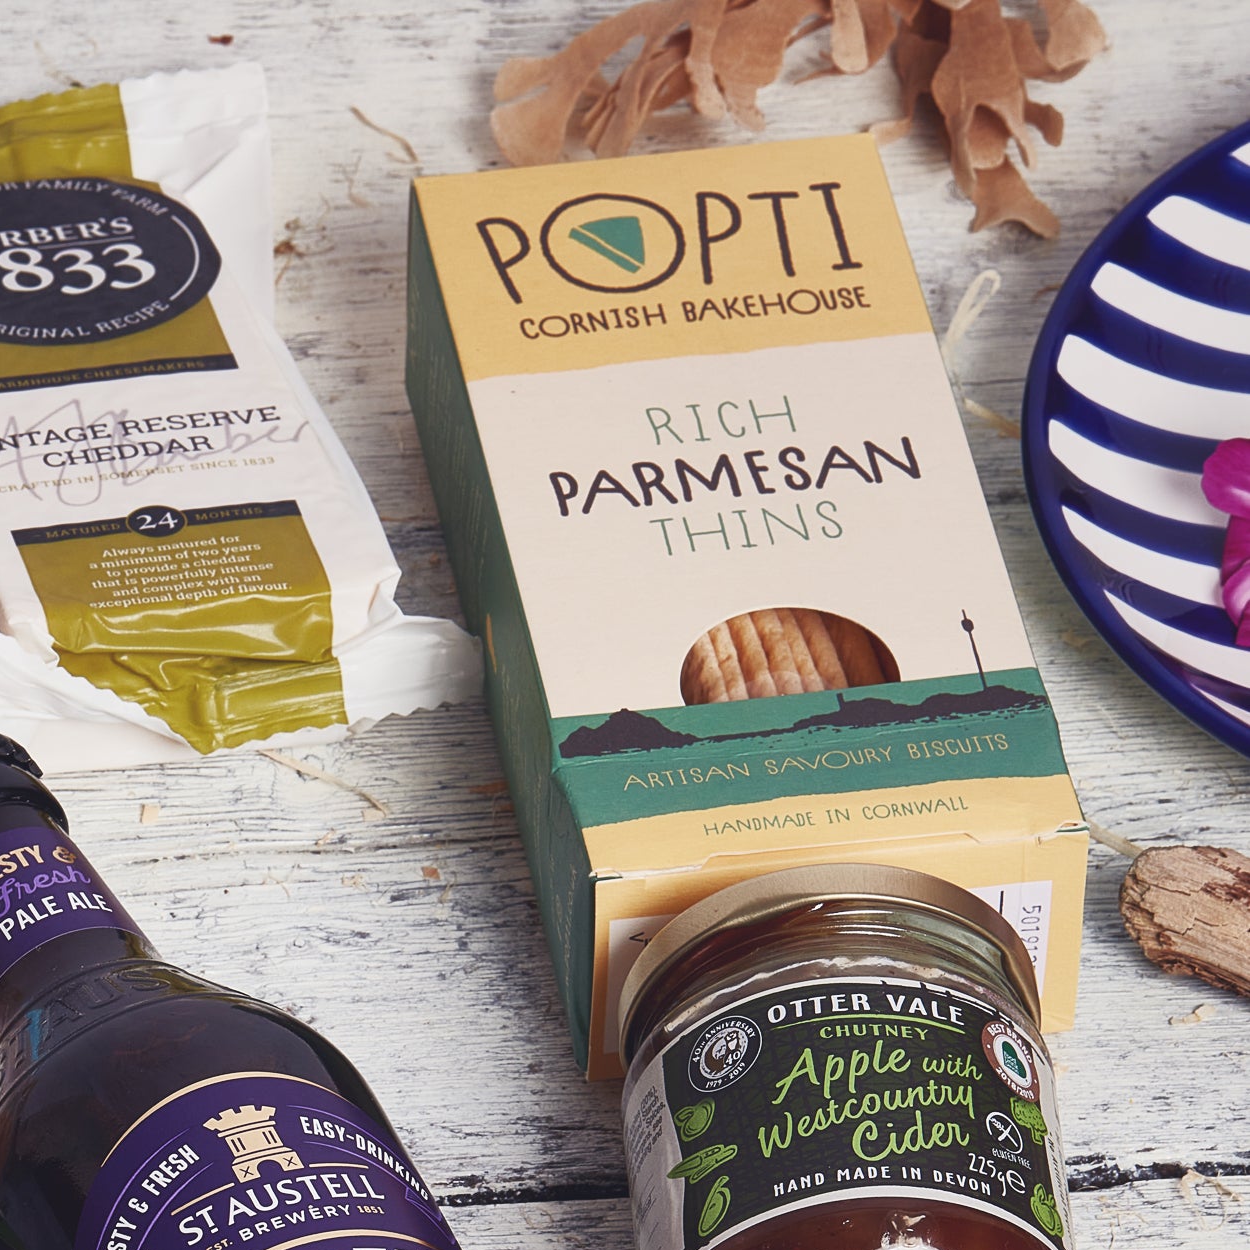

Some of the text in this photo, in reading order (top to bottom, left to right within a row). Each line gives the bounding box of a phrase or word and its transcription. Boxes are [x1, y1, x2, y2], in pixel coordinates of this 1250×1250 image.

[23, 180, 108, 192] FAMILY
[112, 188, 168, 217] FARM
[475, 181, 863, 305] POPTI
[96, 300, 169, 333] RECIPE
[519, 285, 872, 339] CORNISH BAKEHOUSE
[84, 360, 206, 380] CHEESEMAKERS
[121, 406, 281, 437] RESERVE
[644, 395, 797, 445] RICH
[41, 435, 214, 469] CHEDDAR
[77, 475, 94, 484] IN
[99, 465, 185, 482] SOMERSET
[190, 460, 238, 471] SINCE
[243, 456, 275, 465] 1833
[549, 437, 921, 517] PARMESAN
[46, 506, 262, 538] MATURED 24 MONTHS
[649, 501, 843, 556] THINS
[101, 553, 171, 569] minimum
[102, 538, 217, 558] Always matured
[125, 553, 251, 577] provide cheddar
[213, 562, 274, 577] intense
[89, 594, 173, 609] exceptional
[623, 733, 1010, 792] ARTISAN SAVOURY BISCUITS
[703, 796, 969, 836] HANDMADE IN CORNWALL
[52, 846, 77, 864] &
[0, 892, 113, 941] PALE ALE
[768, 993, 964, 1025] OTTER VALE
[706, 1021, 756, 1039] ANNIVERSARY
[819, 1024, 929, 1041] CHUTNEY
[987, 1024, 1032, 1063] BEST BRAND
[706, 1063, 746, 1088] 1979 2019
[771, 1040, 911, 1104] Apple
[922, 1055, 983, 1080] with
[996, 1066, 1035, 1099] 2018/2019
[758, 1080, 976, 1158] Westcountry
[853, 1111, 970, 1161] Cider
[300, 1116, 429, 1201] EASY-DRINKING
[992, 1148, 1031, 1170] GLUTEN FREE
[128, 1198, 149, 1214] &
[141, 1144, 200, 1195] FRESH
[774, 1166, 990, 1196] HAND MADE IN DEVON
[227, 1173, 384, 1226] AUSTELL
[240, 1204, 351, 1242] BREWERY
[357, 1205, 383, 1214] 1851
